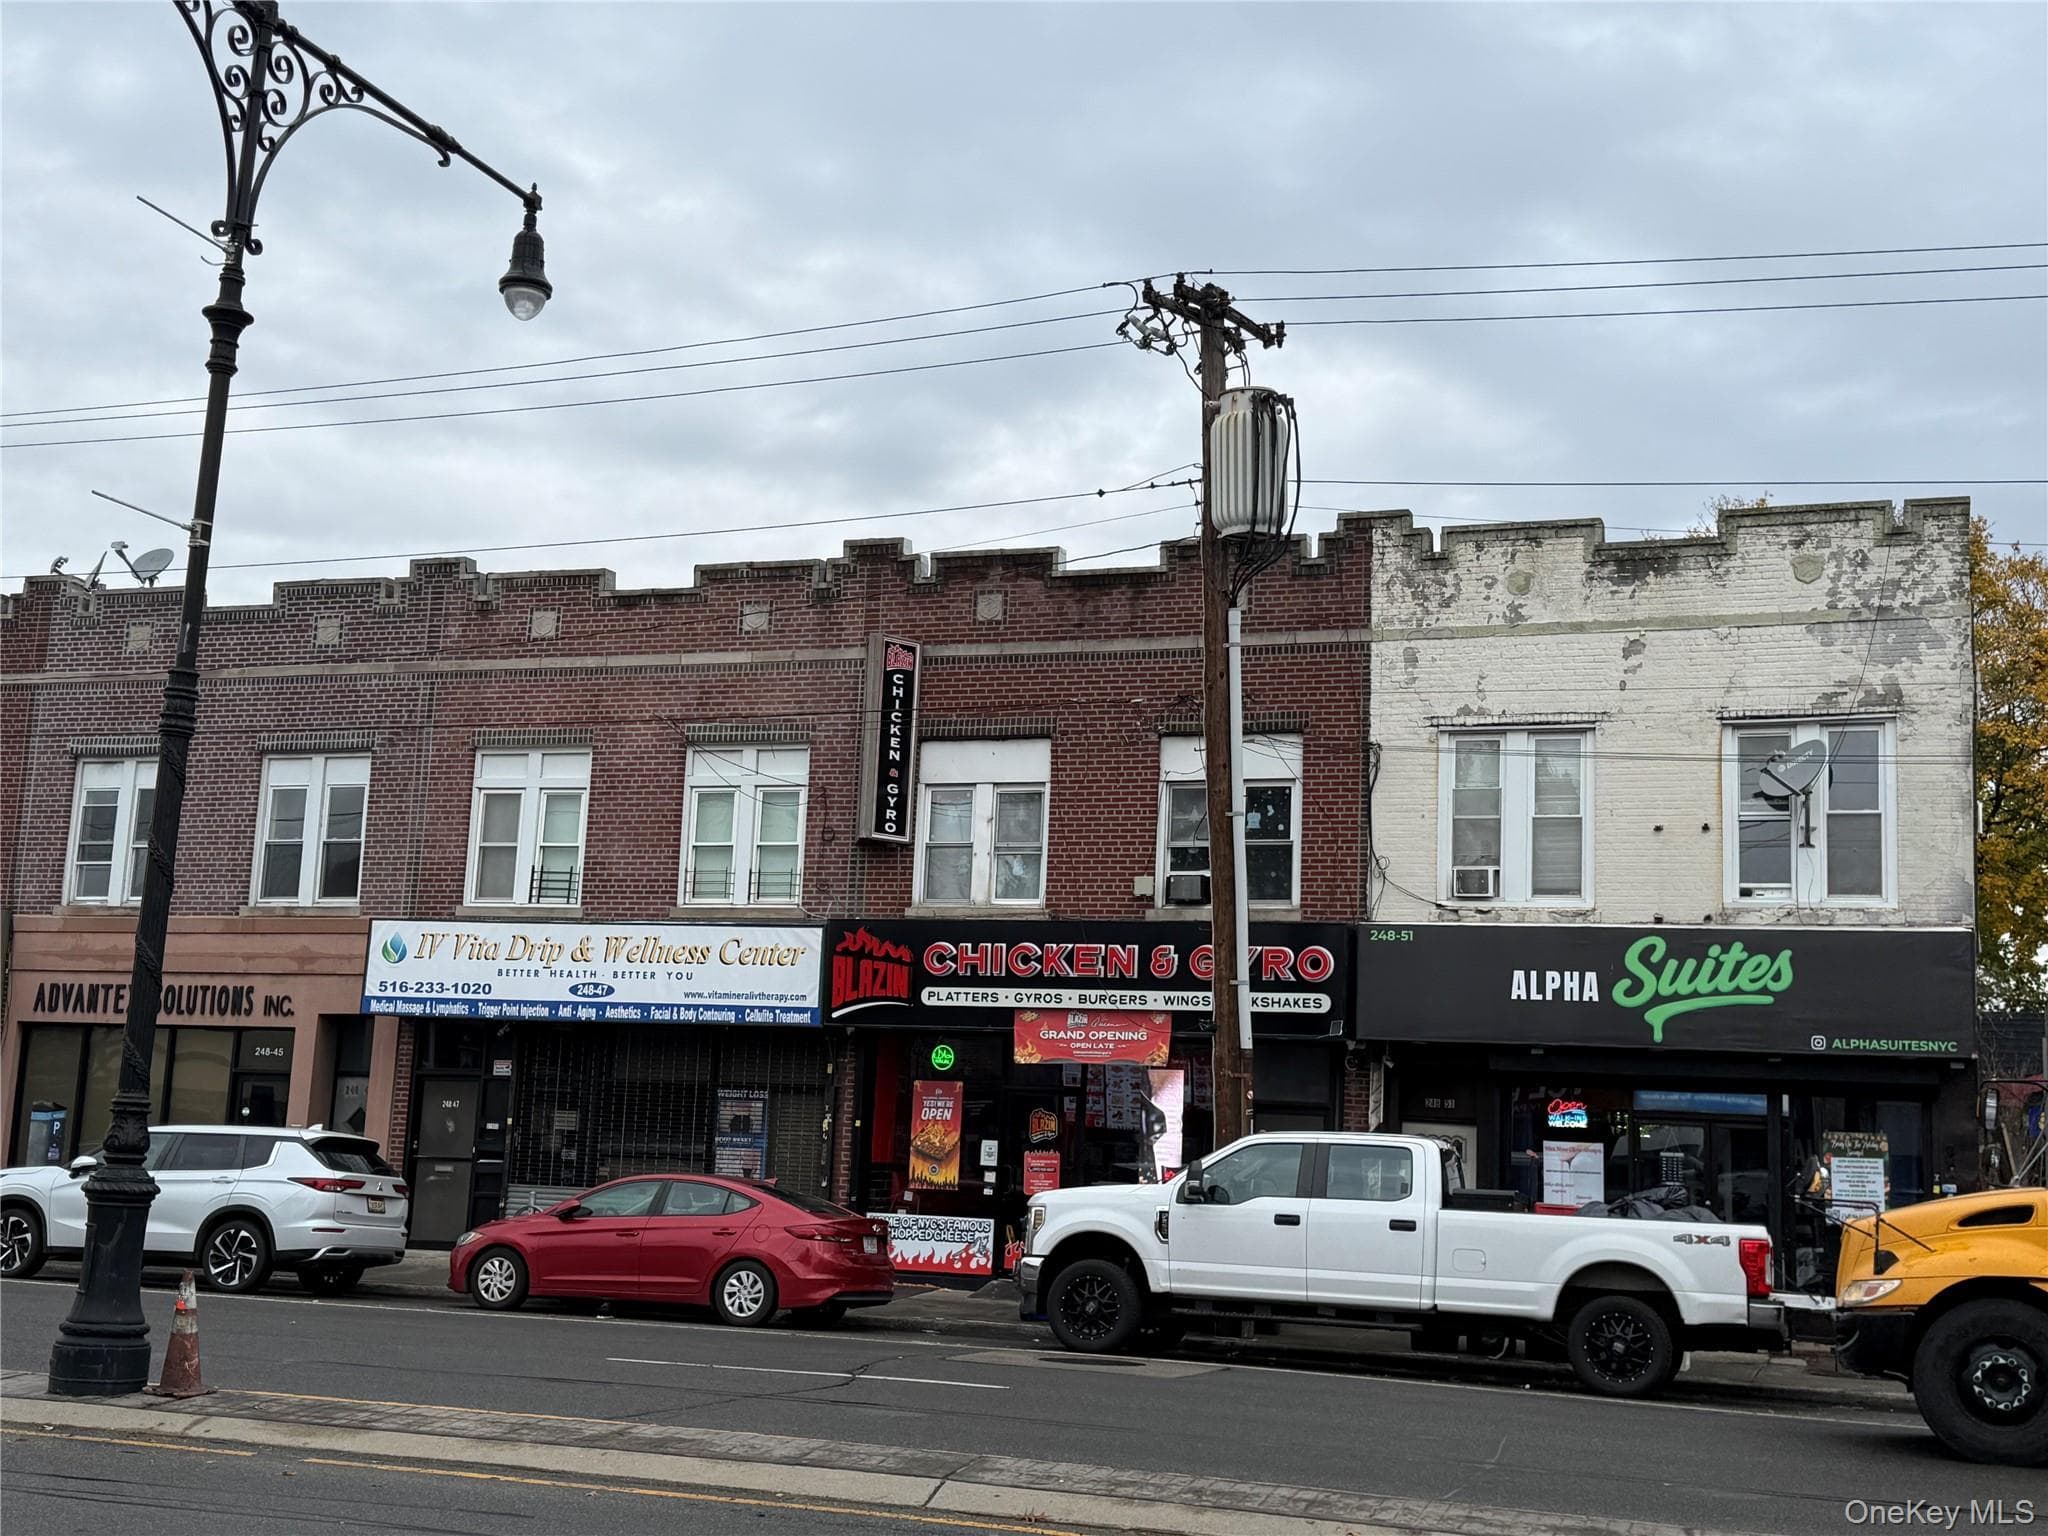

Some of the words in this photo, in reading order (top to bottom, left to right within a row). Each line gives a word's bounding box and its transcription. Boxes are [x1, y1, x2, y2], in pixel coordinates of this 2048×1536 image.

[889, 674, 904, 761] CHICKEN
[889, 768, 899, 778] &
[885, 783, 899, 833] GYRO
[1370, 930, 1414, 941] 248-51
[414, 932, 450, 960] IV
[453, 933, 501, 961] Vita
[505, 934, 565, 969] Drip
[571, 934, 595, 963] &
[604, 936, 712, 965] Wellness
[719, 937, 807, 967] Center
[923, 941, 1139, 979] CHICKEN
[1150, 944, 1178, 979] &
[498, 969, 540, 978] BETTER
[550, 970, 597, 979] HEALTH
[612, 971, 656, 980] BETTER
[667, 972, 694, 981] YOU
[1511, 970, 1600, 1002] ALPHA
[1612, 936, 1793, 1008] Suites
[378, 981, 492, 995] 516-233-1020
[832, 955, 912, 1009] BLAZIN
[576, 984, 608, 996] 248-47
[33, 982, 134, 1013] ADVANTE
[264, 995, 295, 1016] INC.
[927, 991, 999, 1003] PLATTERS
[1014, 993, 1063, 1004] GYROS
[1079, 994, 1148, 1006] BURGERS
[1163, 995, 1211, 1007] WINGS
[1251, 997, 1322, 1009] KSHAKES
[370, 1000, 395, 1013] Medical
[396, 1001, 424, 1015] Massage
[432, 1001, 469, 1017] Lymphatics
[478, 1002, 501, 1018] Trigger
[502, 1003, 519, 1016] Point
[521, 1003, 549, 1018] Injection
[558, 1004, 572, 1017] Anti
[576, 1005, 596, 1020] Aging
[605, 1006, 641, 1019] Aesthetics
[650, 1006, 671, 1020] Facial
[680, 1007, 698, 1023] Body
[699, 1008, 736, 1024] Contouring
[744, 1009, 773, 1023] Cellulite
[775, 1010, 811, 1025] Treatment
[1040, 1030, 1086, 1040] GRAND
[1089, 1031, 1148, 1041] OPENING
[255, 1047, 284, 1056] 248-45
[1832, 1037, 1958, 1052] ALPHASUITESNYC
[717, 1089, 748, 1098] WEIGHT
[921, 1108, 952, 1120] OPEN
[1548, 1099, 1588, 1114] Open
[901, 1216, 916, 1228] OF
[948, 1220, 991, 1233] FAMOUS
[887, 1227, 934, 1240] HOPPED
[934, 1229, 975, 1243] CHEESE
